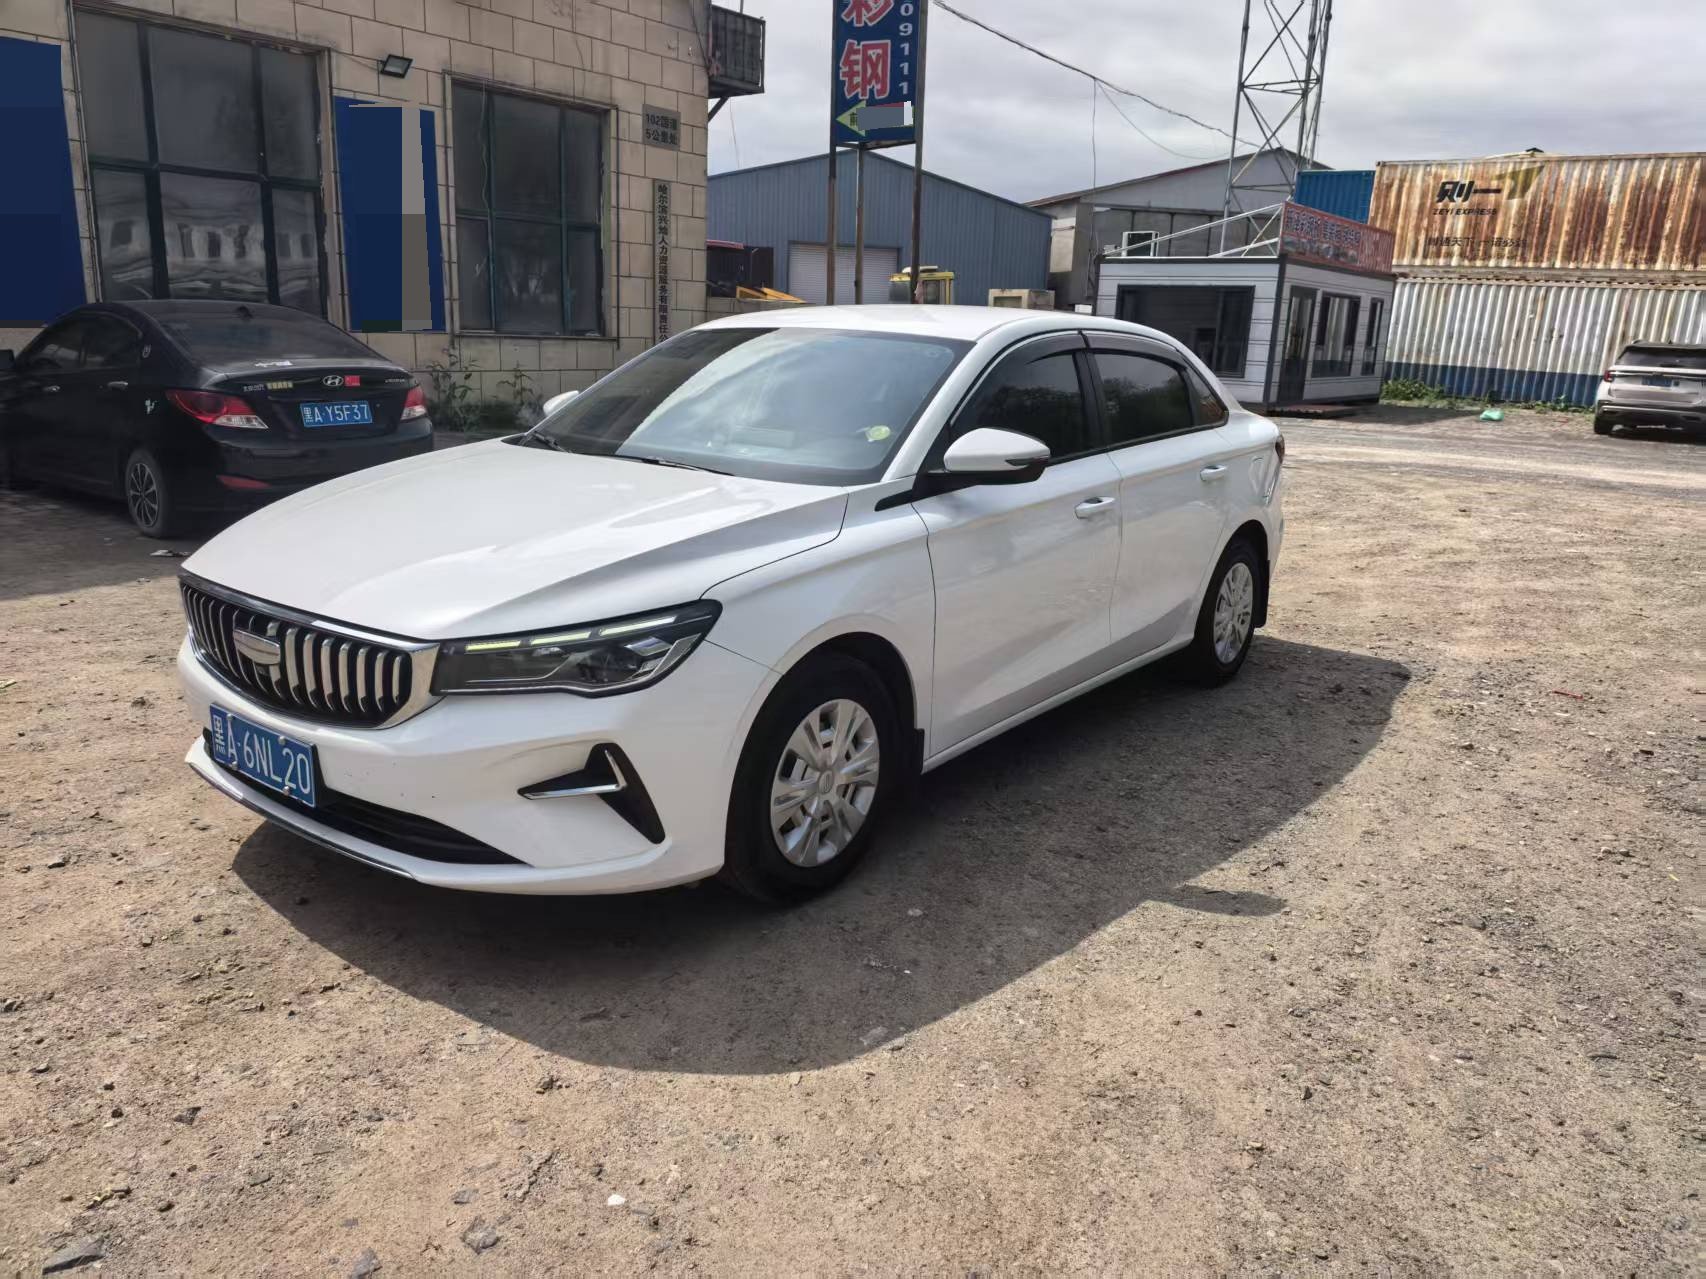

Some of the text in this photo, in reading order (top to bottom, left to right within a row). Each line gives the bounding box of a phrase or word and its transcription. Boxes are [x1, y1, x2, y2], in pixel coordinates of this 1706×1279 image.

[898, 0, 914, 95] 09111
[1432, 207, 1498, 216] ZEYI EXPRESS
